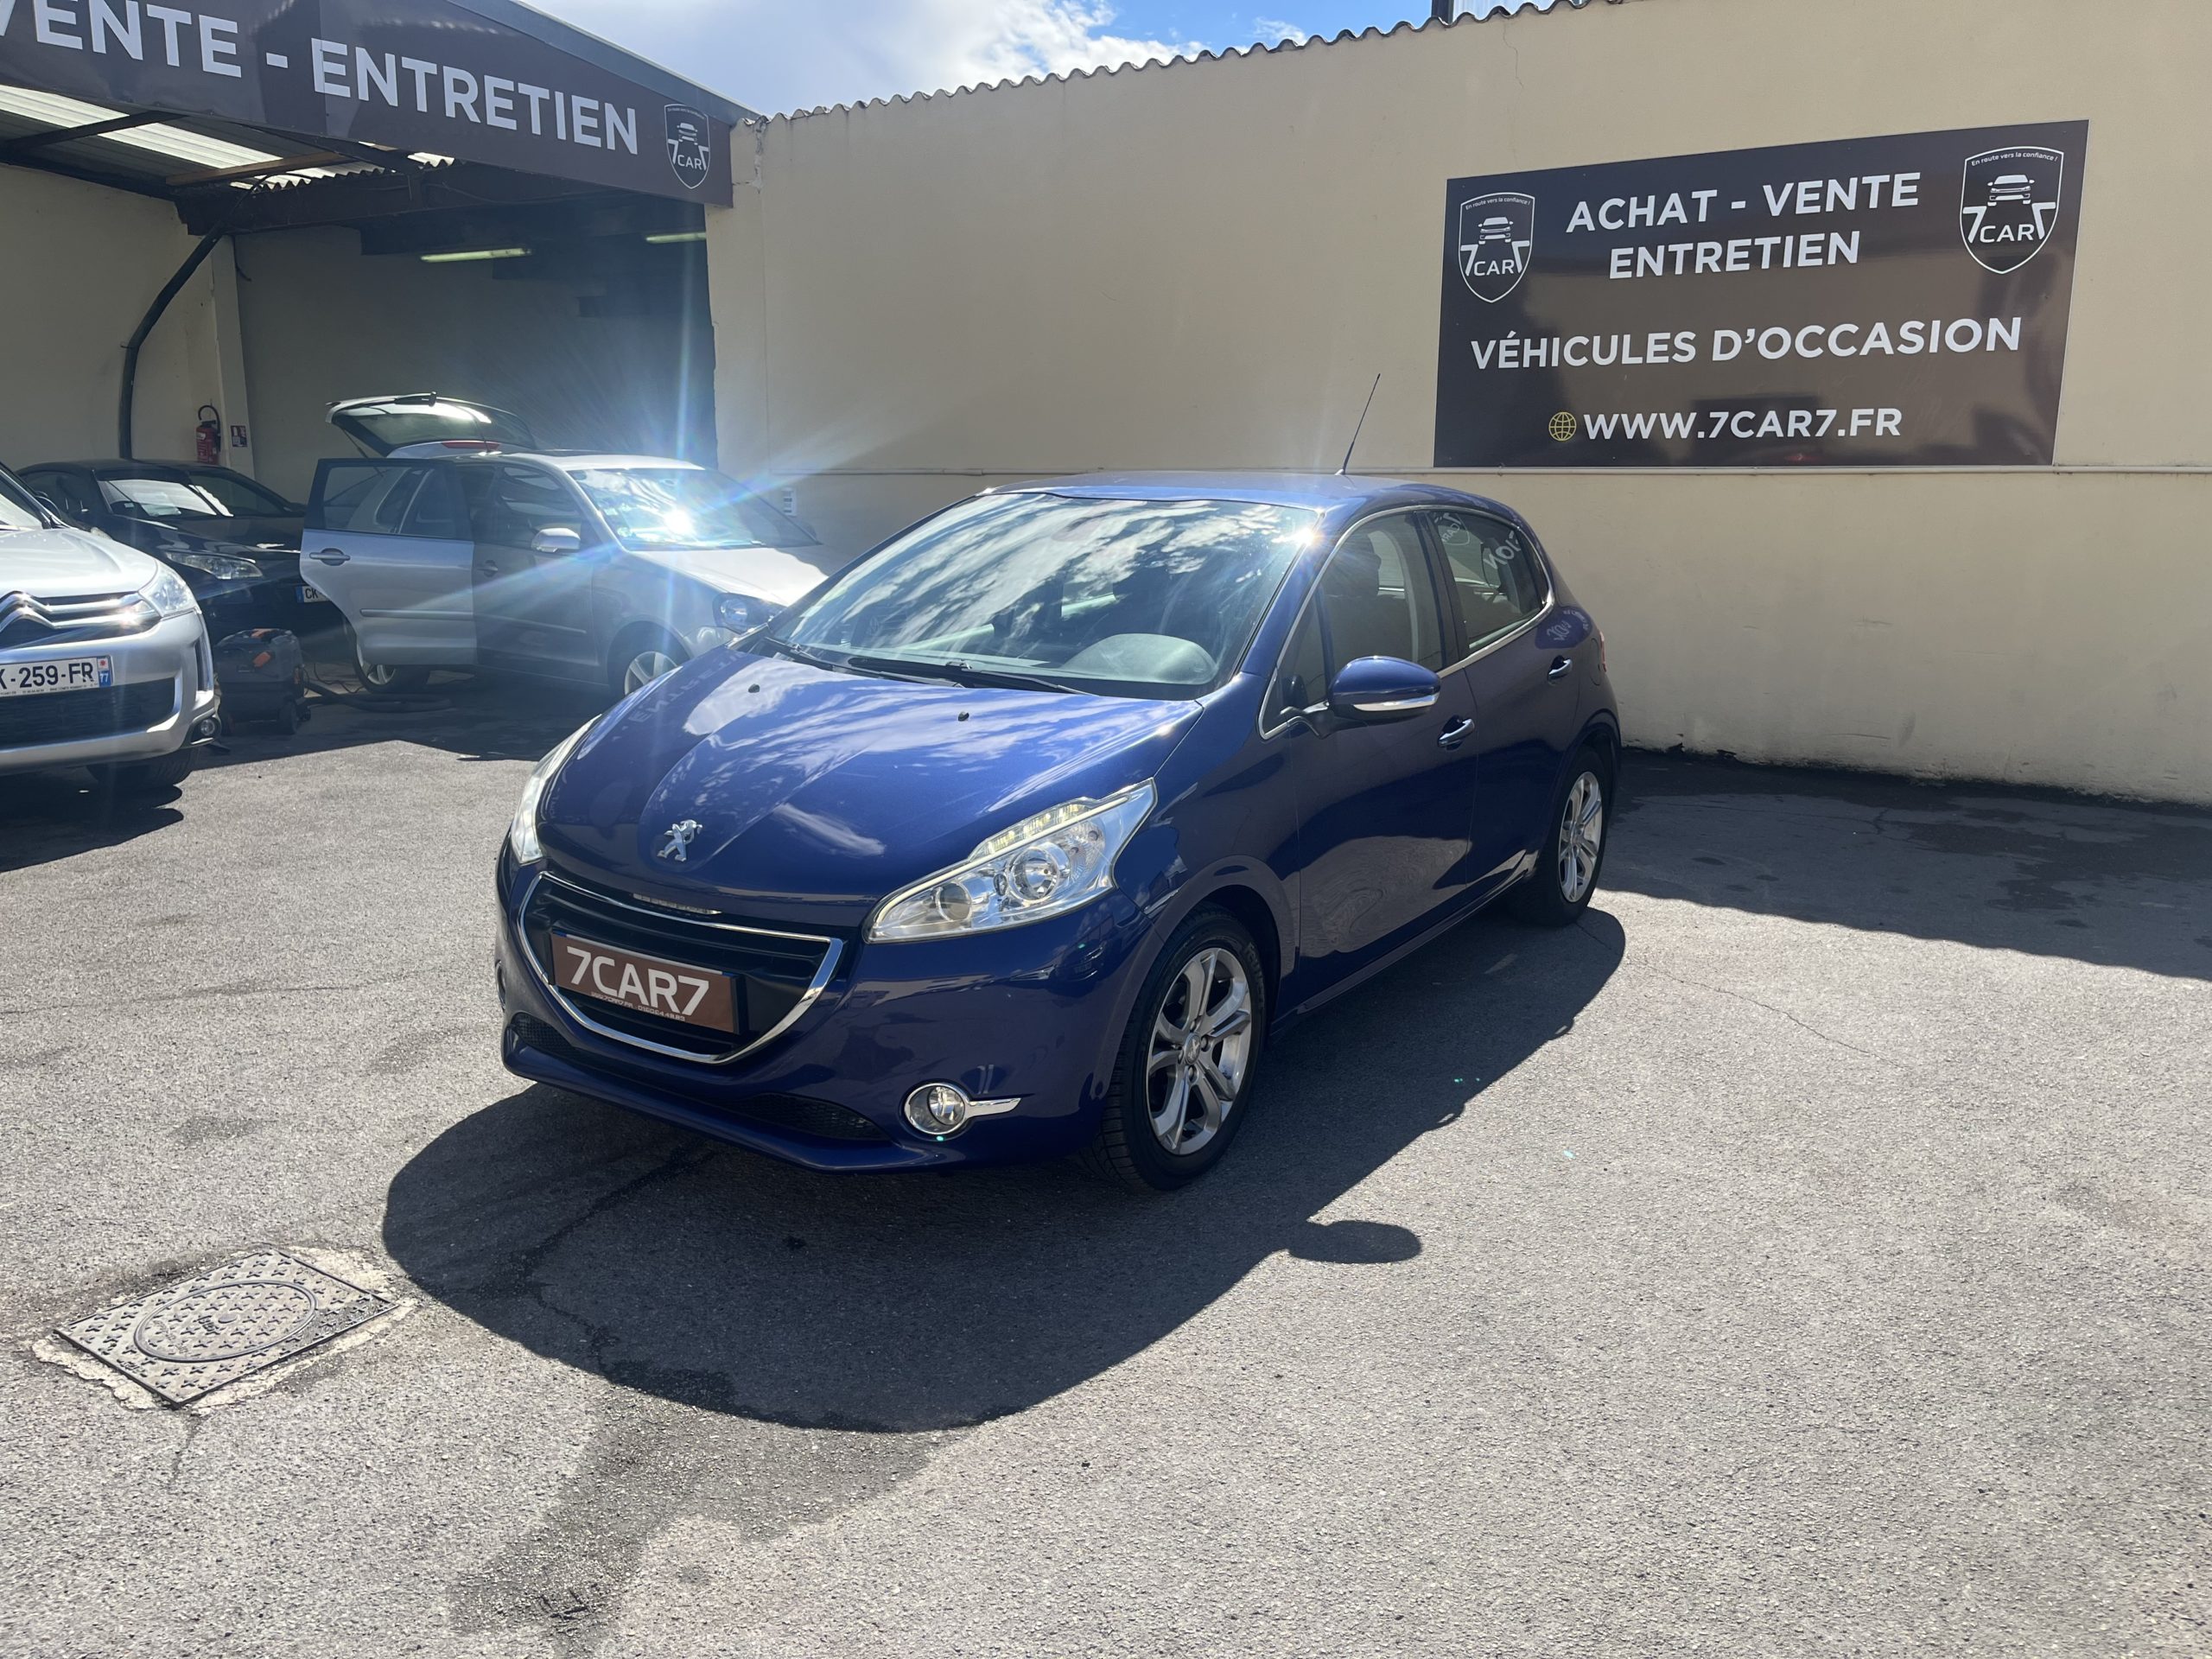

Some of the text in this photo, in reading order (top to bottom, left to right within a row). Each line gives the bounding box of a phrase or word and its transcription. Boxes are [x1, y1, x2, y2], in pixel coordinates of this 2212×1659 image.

[311, 37, 638, 155] ENTRETIEN
[2023, 151, 2055, 162] confiance
[1566, 189, 1718, 232] ACHAT
[1763, 172, 1922, 216] VENTE
[1609, 231, 1860, 280] ENTRETIEN
[1471, 330, 1696, 370] VÉHICULES
[1583, 408, 1902, 440] WWW.7CAR7.FR
[567, 945, 709, 1016] 7CAR7
